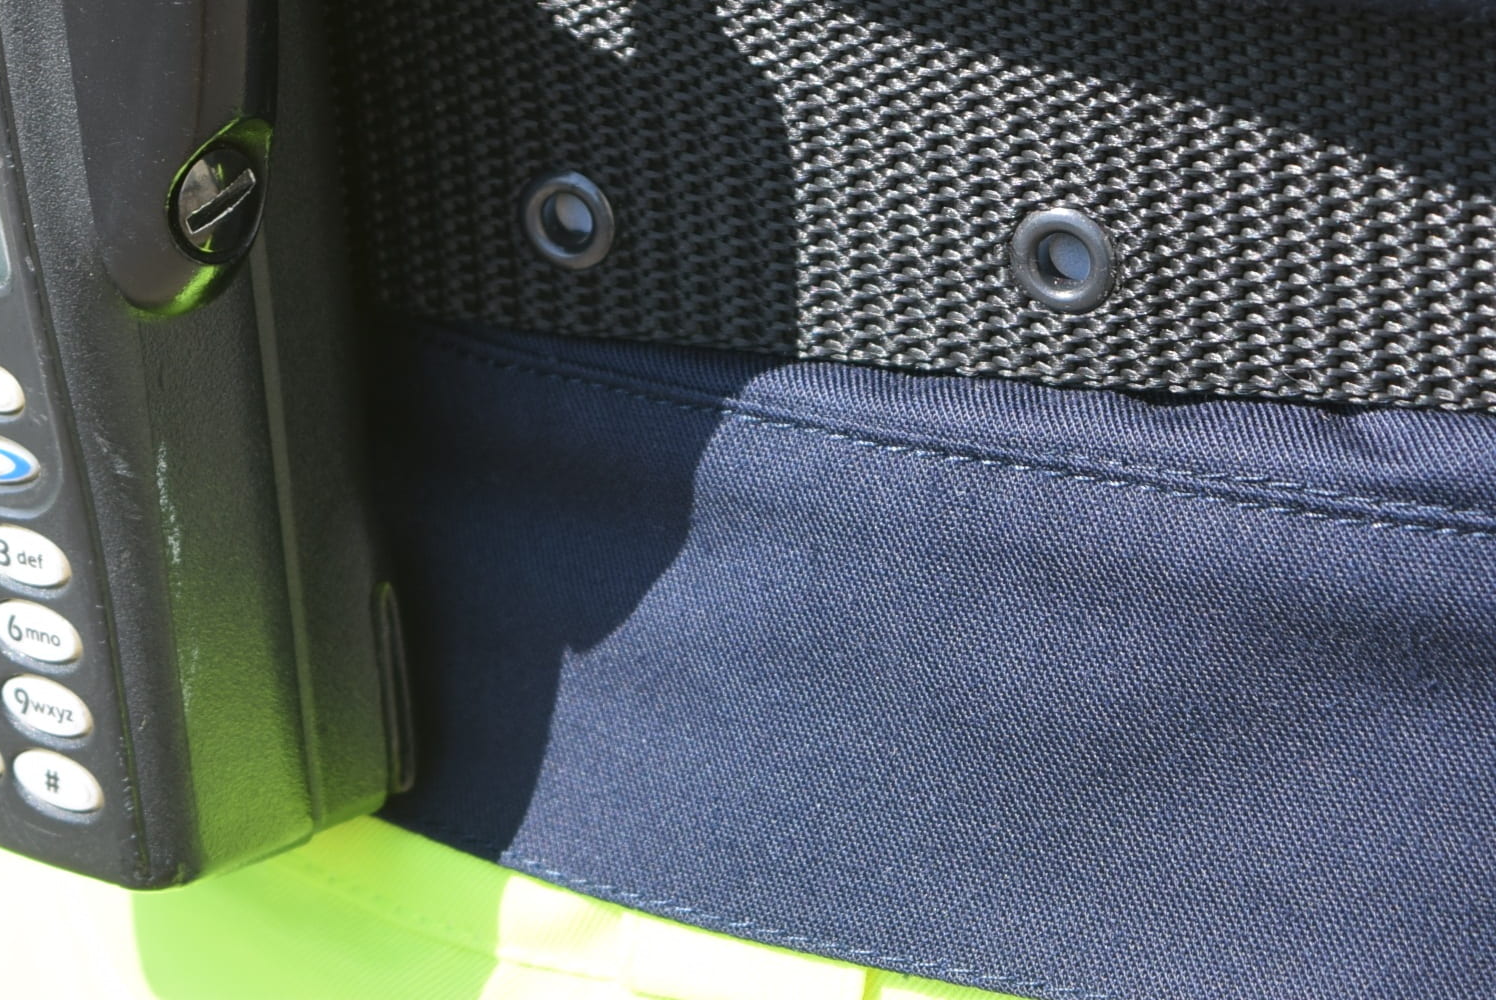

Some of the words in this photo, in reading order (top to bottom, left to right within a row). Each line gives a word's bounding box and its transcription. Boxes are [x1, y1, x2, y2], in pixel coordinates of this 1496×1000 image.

[17, 550, 44, 569] def
[8, 615, 23, 641] 6
[25, 627, 61, 647] mno
[14, 688, 30, 714] 9
[30, 701, 74, 723] wxyz
